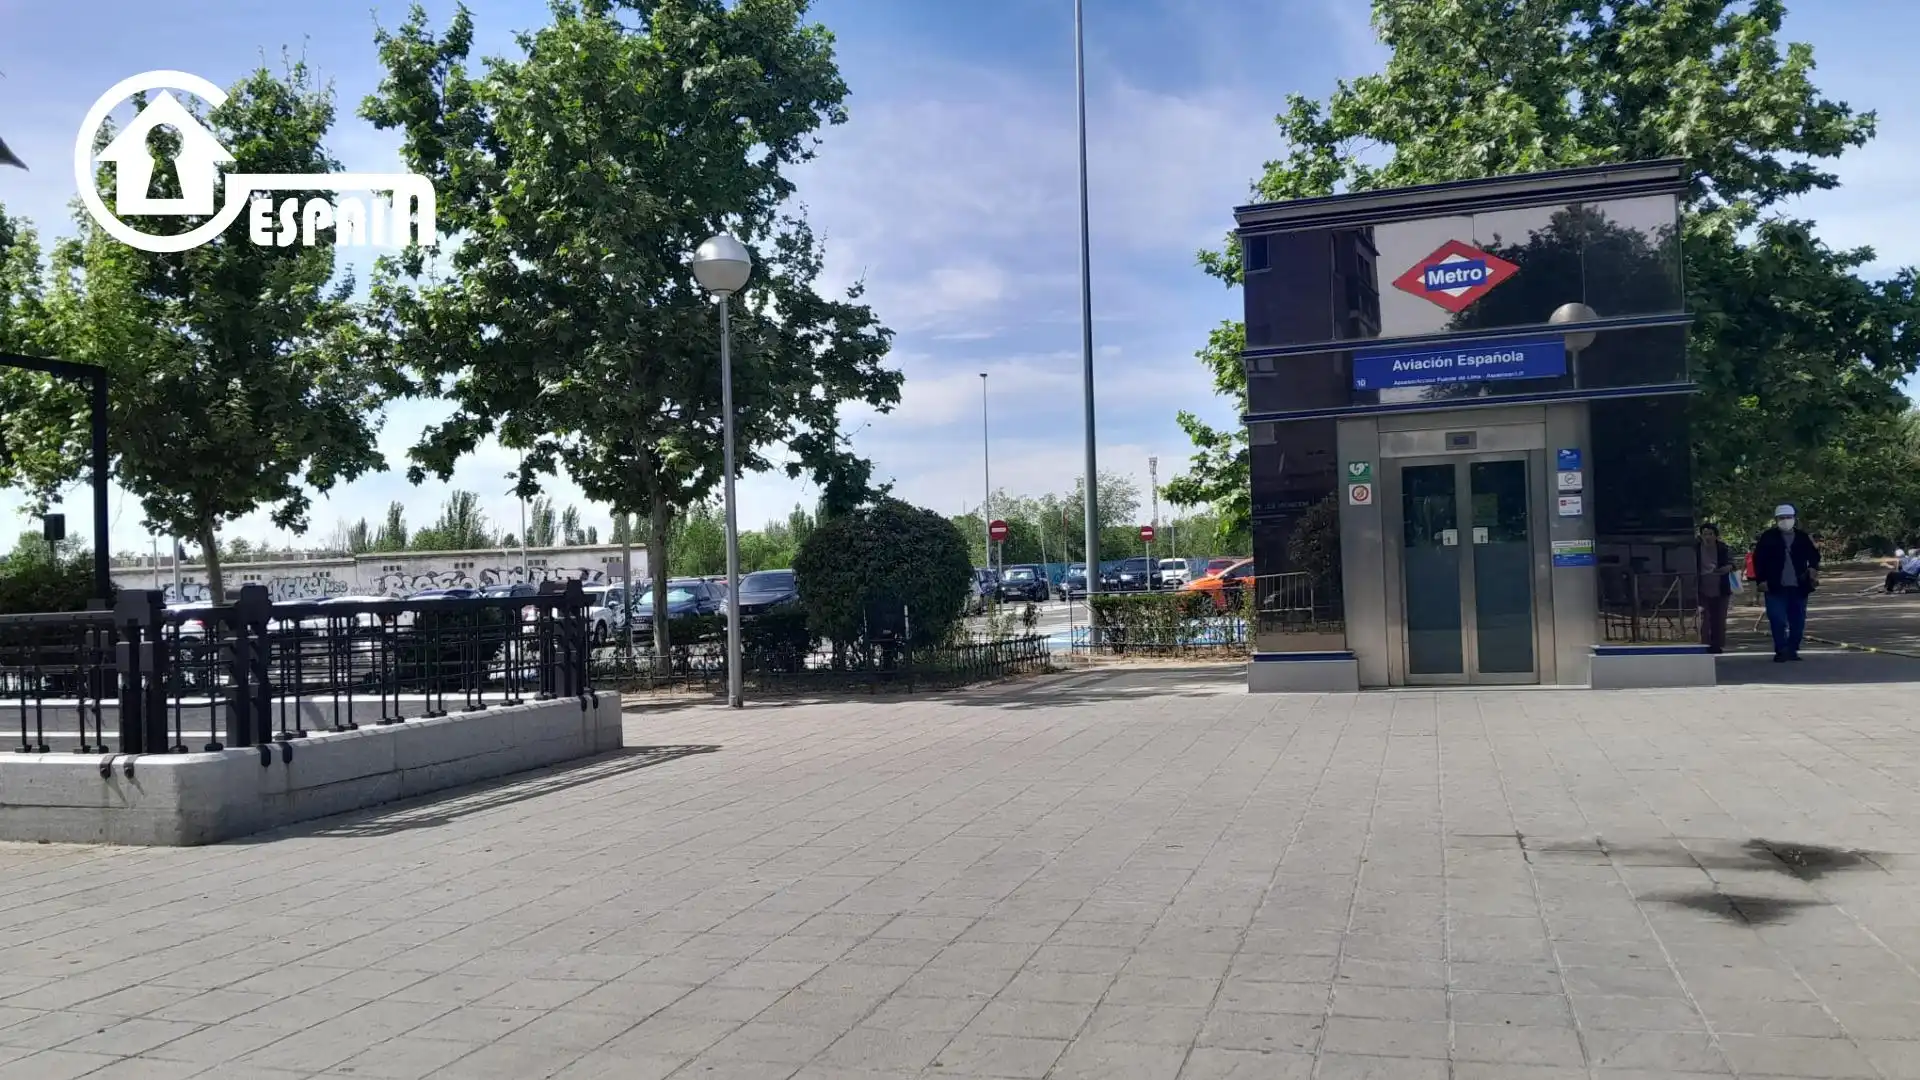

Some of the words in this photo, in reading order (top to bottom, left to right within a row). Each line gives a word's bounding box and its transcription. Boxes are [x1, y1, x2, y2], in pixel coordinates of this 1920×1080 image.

[1427, 267, 1483, 286] Metro
[1392, 355, 1453, 372] Aviación
[1457, 350, 1524, 367] Española
[1356, 378, 1367, 387] 10
